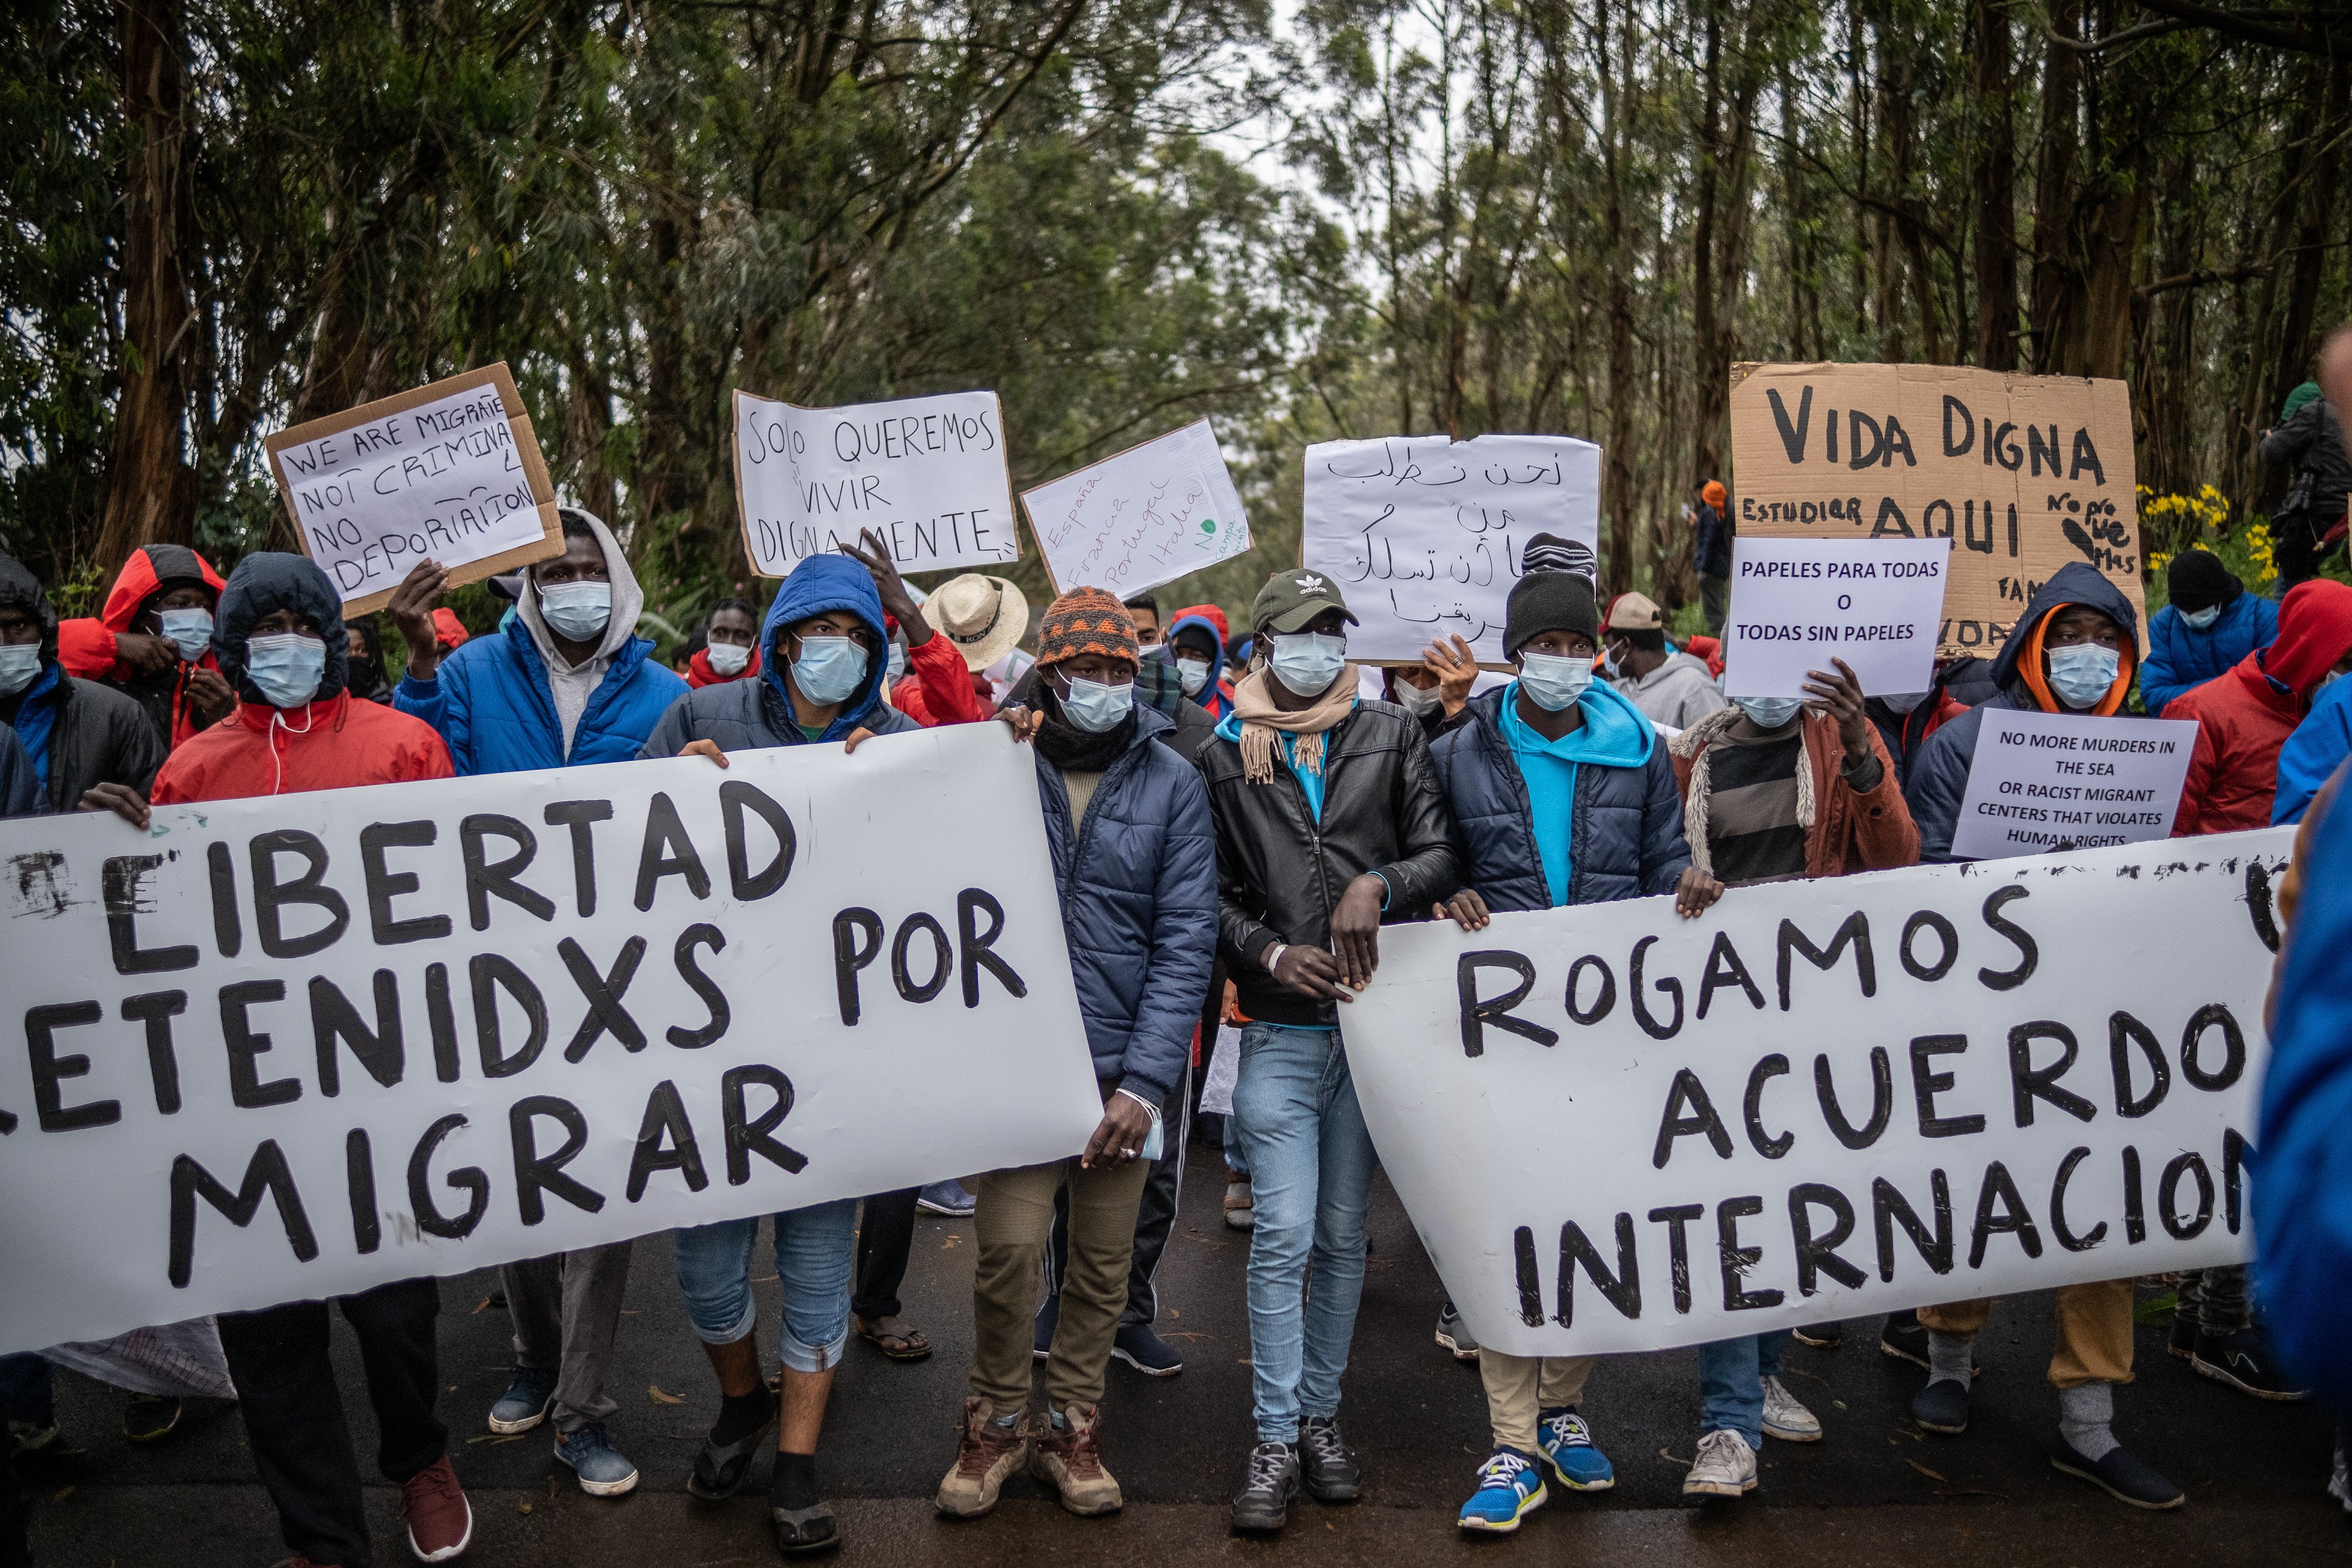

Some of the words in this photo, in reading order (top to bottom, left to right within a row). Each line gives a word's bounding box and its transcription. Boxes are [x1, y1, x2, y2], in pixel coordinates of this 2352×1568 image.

[286, 440, 339, 472] WE
[353, 419, 403, 457] ARE
[749, 411, 804, 464] SOLO
[835, 410, 994, 462] QUEREMOS
[1766, 385, 1917, 470] VIDA
[1942, 394, 2106, 486] DIGNA
[1328, 442, 1466, 486] نطلب
[1485, 452, 1561, 486] نحن
[300, 467, 362, 514] NOT
[799, 475, 891, 514] VIVIR
[1048, 477, 1102, 547] España
[312, 518, 362, 553] NO
[333, 480, 535, 591] DEPORTATION
[1457, 502, 1515, 533] من
[1869, 496, 2019, 557] AQUI
[1742, 561, 1821, 578] PAPELES
[1828, 561, 1876, 578] PARA
[1882, 561, 1939, 578] TODAS
[1838, 594, 1851, 610] O
[1737, 624, 1802, 641] TODAS
[1808, 625, 1838, 641] SIN
[1844, 624, 1914, 641] PAPELES
[1999, 731, 2024, 745] NO
[2030, 734, 2078, 750] MORE
[2082, 738, 2156, 753] MURDERS
[2159, 741, 2176, 754] IN
[2056, 761, 2083, 775] THE
[2087, 763, 2114, 776] SEA
[1999, 781, 2023, 795] OR
[2027, 784, 2082, 800] RACIST
[2084, 788, 2155, 802] MIGRANT
[1977, 803, 2048, 821] CENTERS
[2053, 810, 2093, 824] THAT
[2096, 812, 2162, 825] VIOLATES
[2075, 835, 2126, 847] RIGHTS
[102, 780, 797, 975] LIBERTAD
[1458, 884, 2039, 1058] ROGAMOS
[0, 923, 731, 1135] ETENIDXS
[833, 887, 1028, 1027] POR
[1653, 1002, 2246, 1169] ACUERDO
[168, 1063, 809, 1289] MIGRAR
